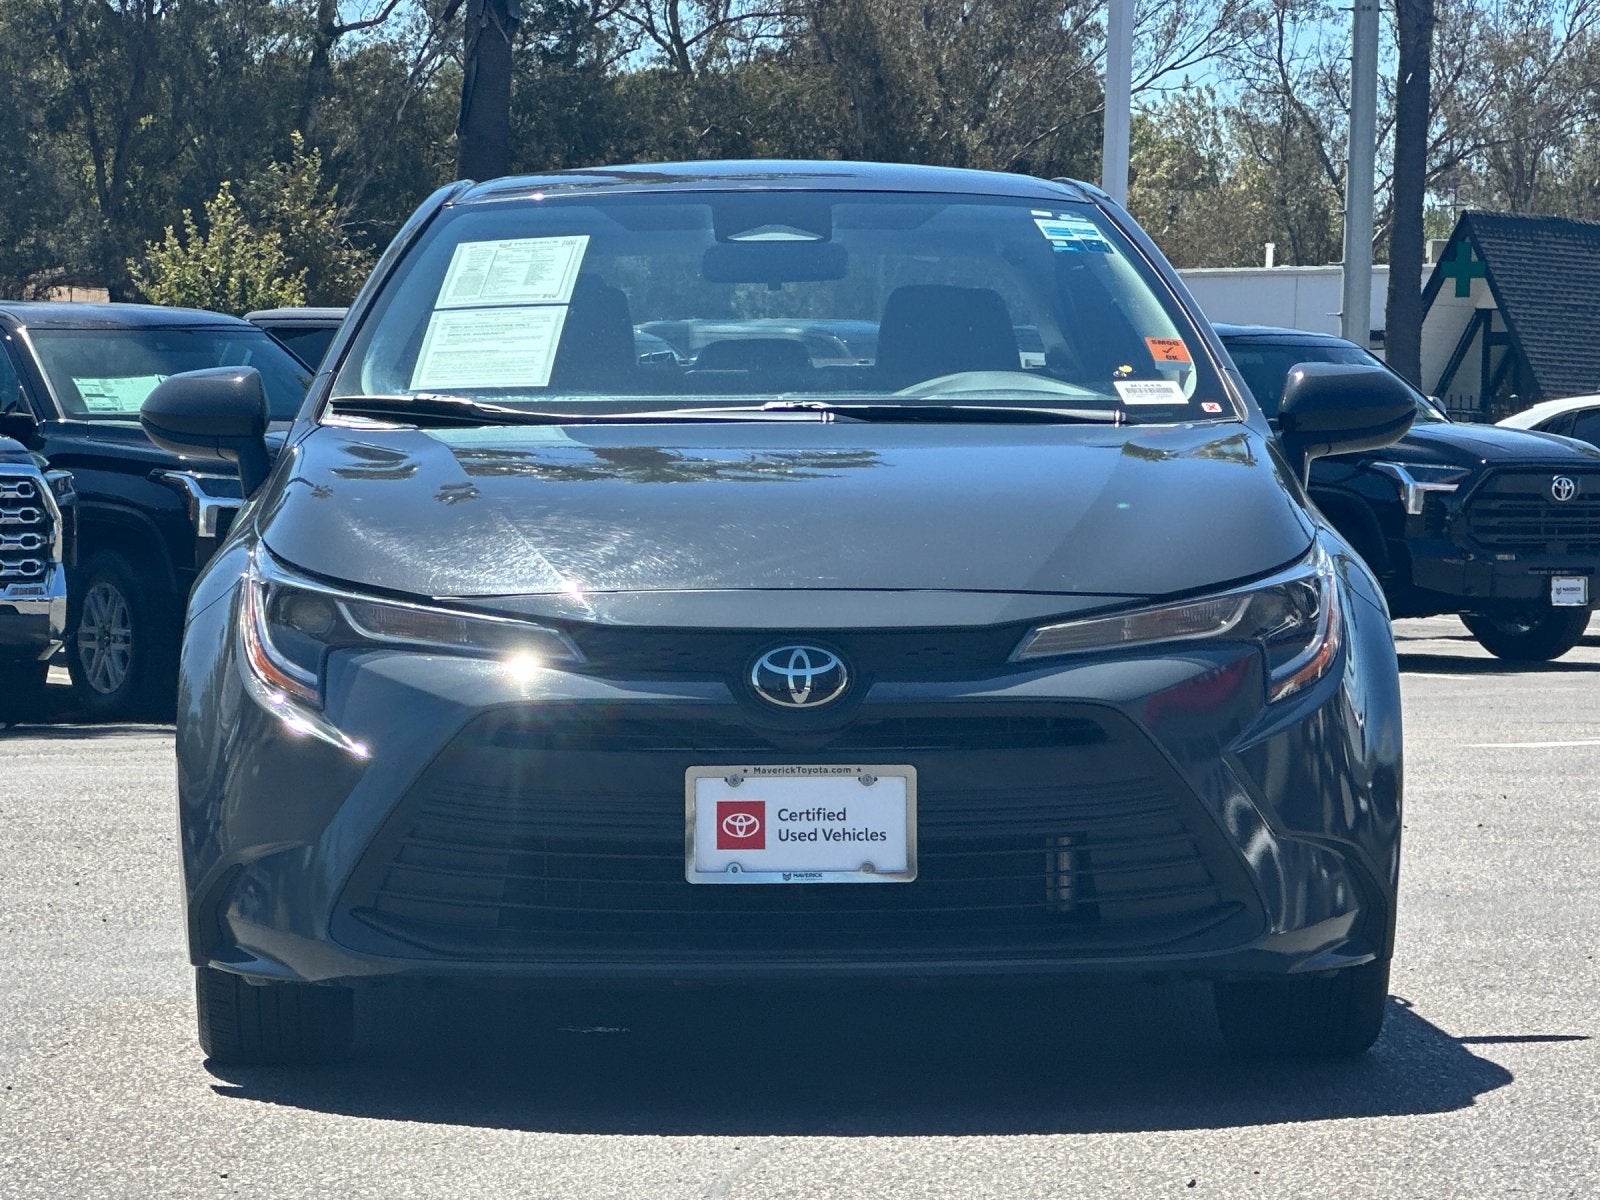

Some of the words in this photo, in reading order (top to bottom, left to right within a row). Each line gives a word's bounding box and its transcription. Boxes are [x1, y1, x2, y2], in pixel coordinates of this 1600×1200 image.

[1151, 339, 1180, 347] SMOG
[753, 766, 851, 775] MaverickToyota.com
[777, 807, 847, 822] Certified
[777, 828, 818, 842] Used
[822, 828, 887, 842] Vehicles
